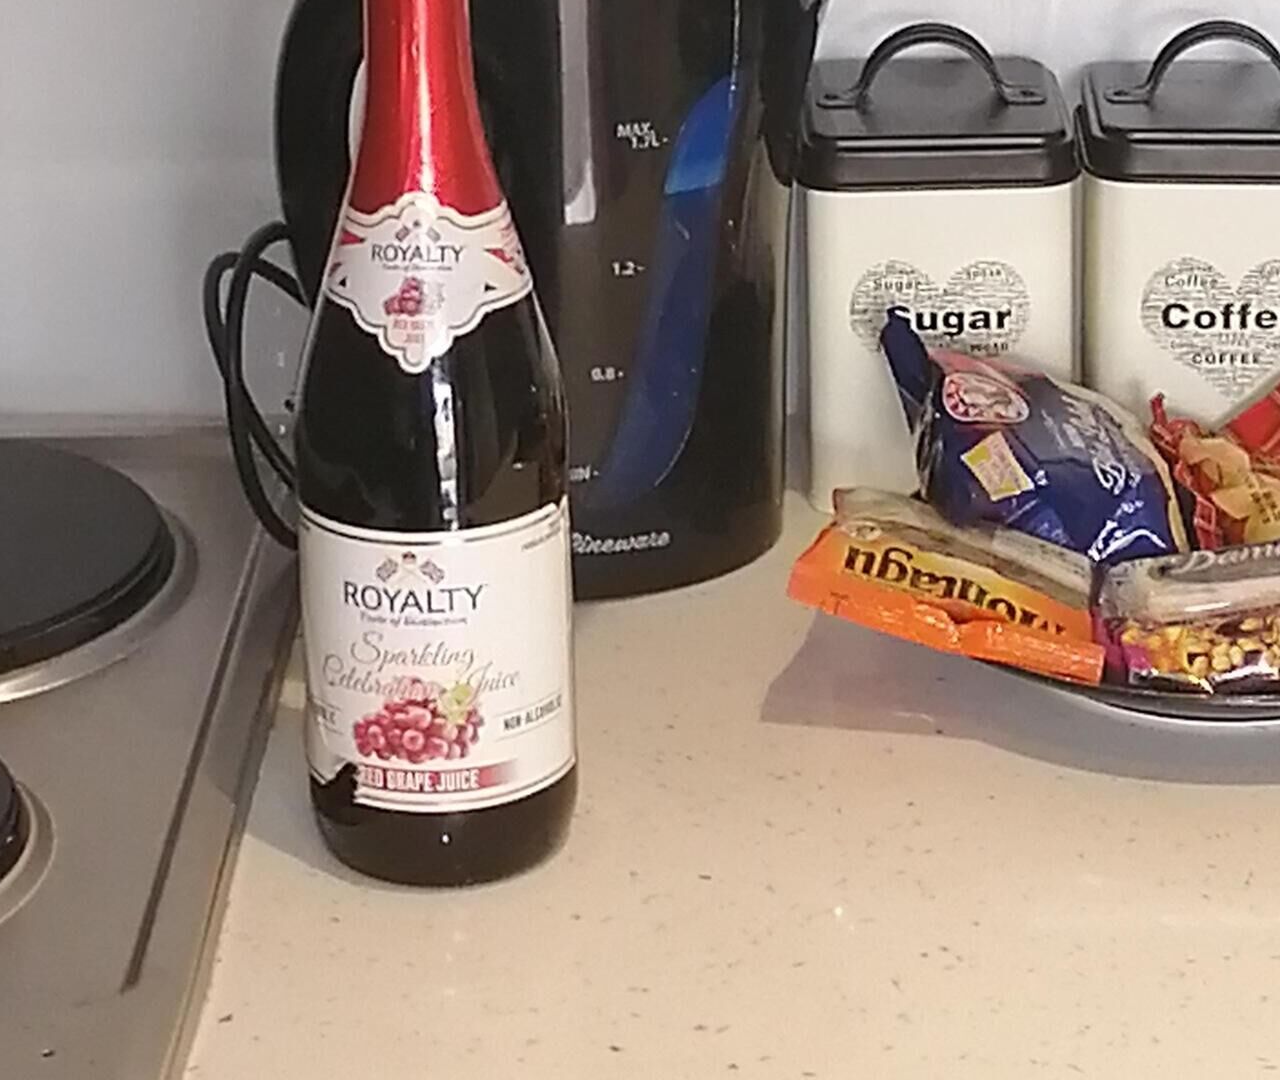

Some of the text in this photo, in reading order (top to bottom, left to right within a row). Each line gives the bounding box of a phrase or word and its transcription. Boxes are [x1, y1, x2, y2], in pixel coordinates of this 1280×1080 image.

[616, 122, 652, 139] MAX
[370, 244, 466, 264] ROYALTY
[612, 261, 635, 276] 1.2
[872, 278, 922, 294] Sugar
[1191, 352, 1262, 365] COFFEE
[343, 580, 484, 614] ROYALTY
[350, 630, 476, 674] Sparkling
[386, 769, 435, 792] GRAPE
[435, 768, 480, 792] JUICE
